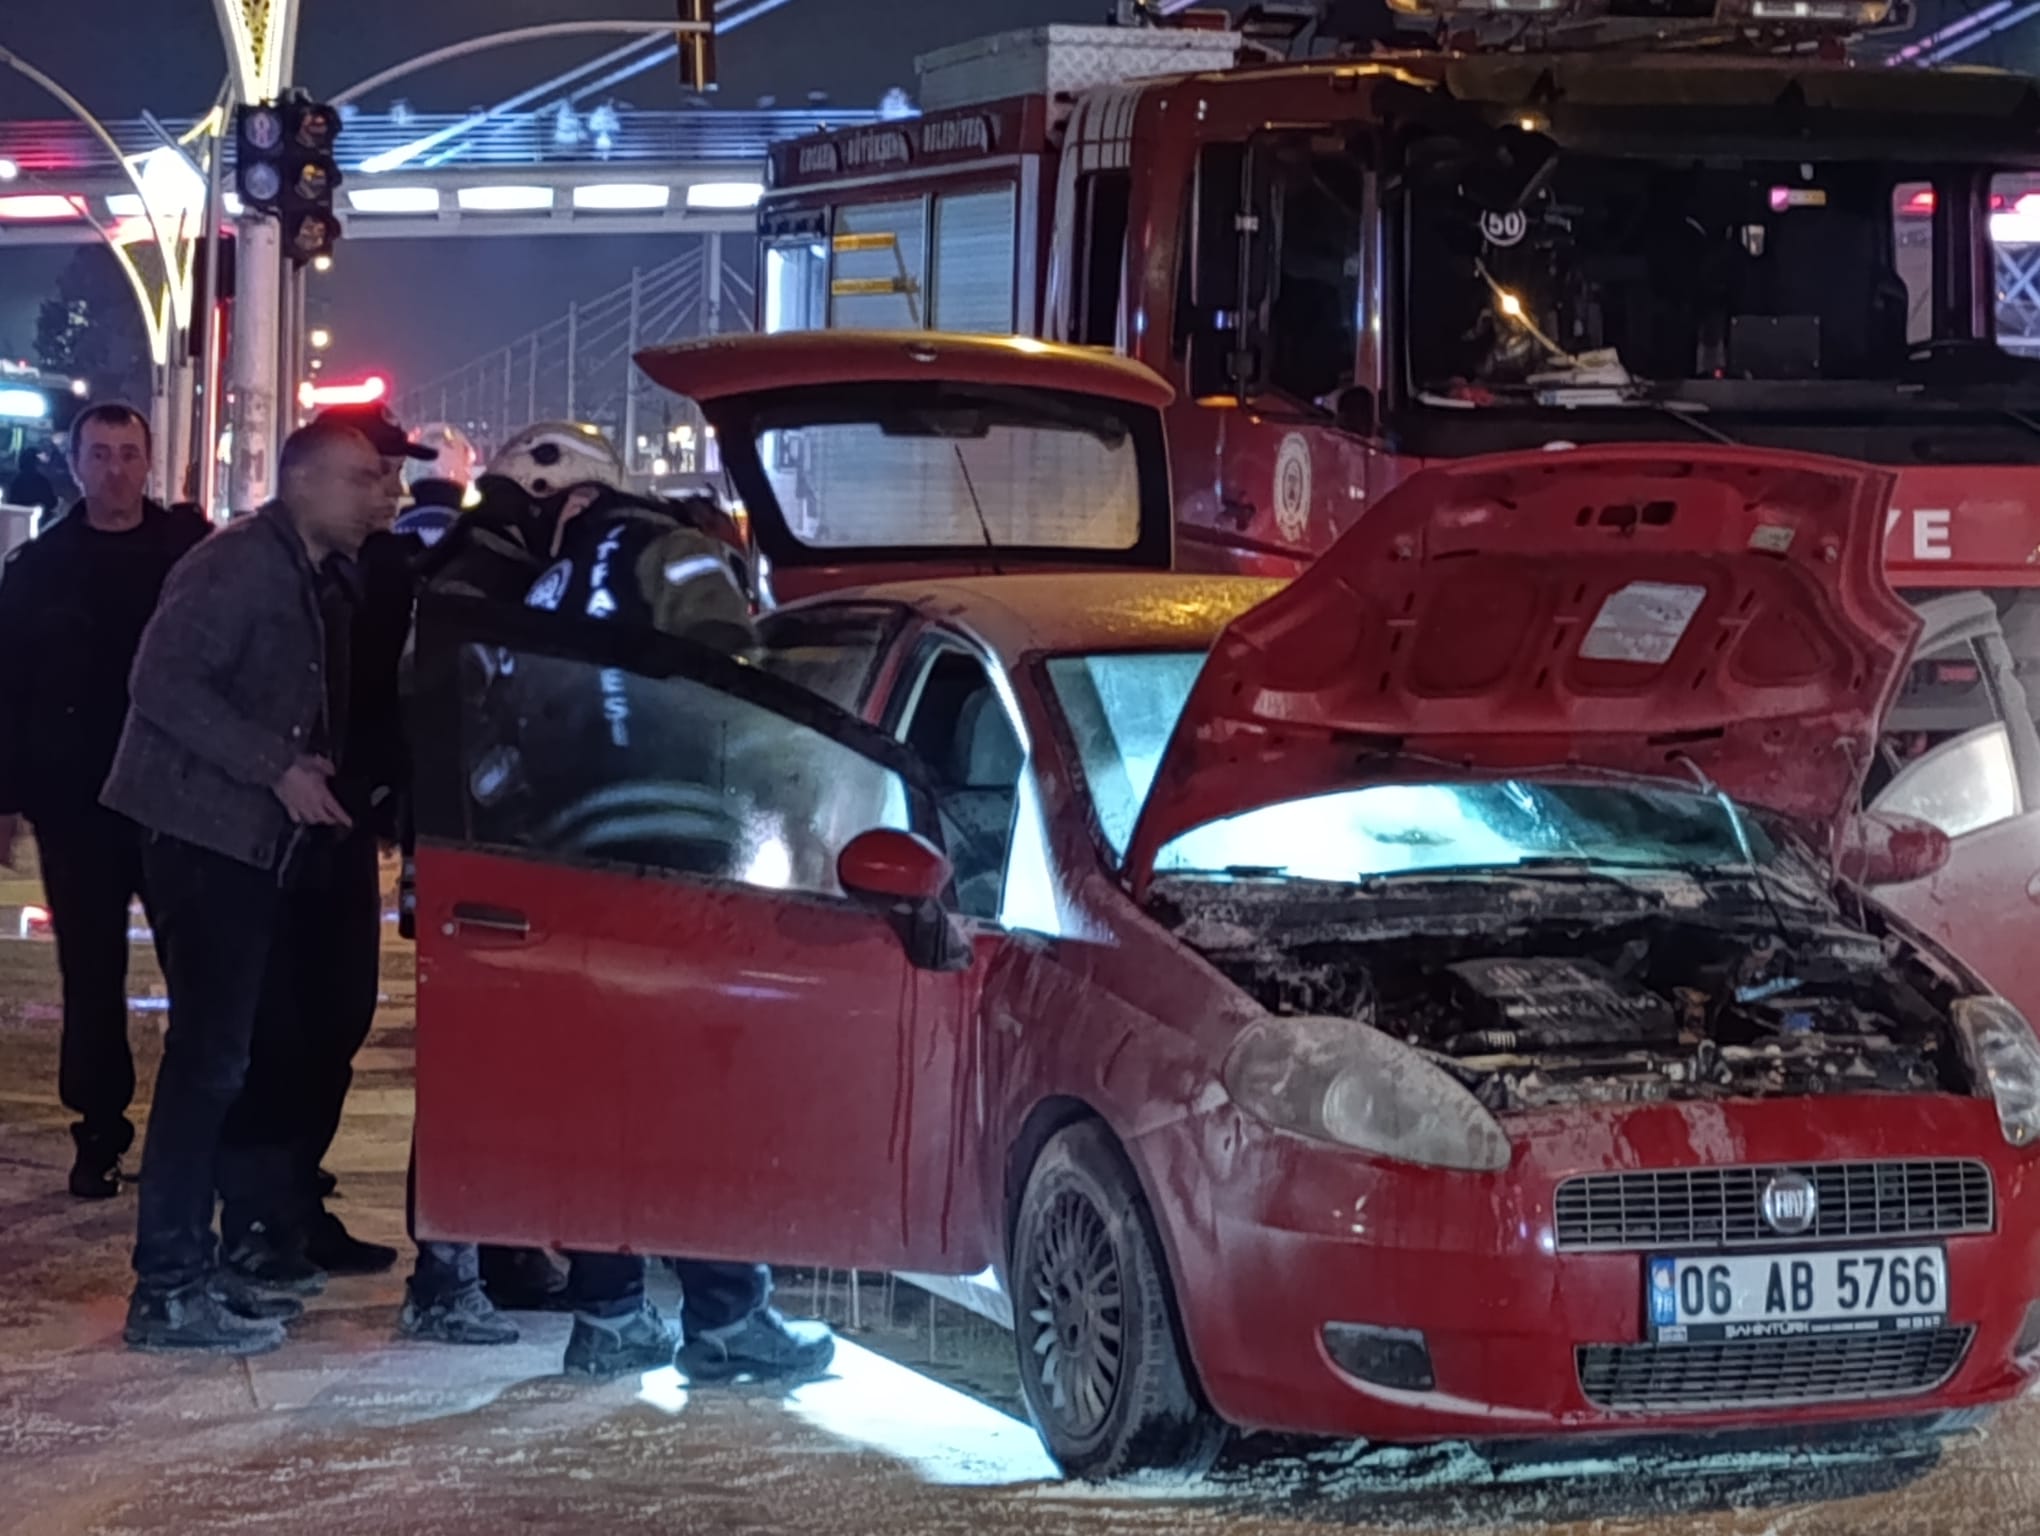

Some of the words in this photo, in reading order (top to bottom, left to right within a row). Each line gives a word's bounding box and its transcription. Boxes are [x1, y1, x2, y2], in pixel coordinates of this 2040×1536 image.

[1488, 211, 1520, 236] 50
[1774, 1189, 1806, 1219] FIAT
[1680, 1264, 1732, 1316] 06
[1765, 1260, 1814, 1314] AB
[1837, 1255, 1937, 1310] 5766
